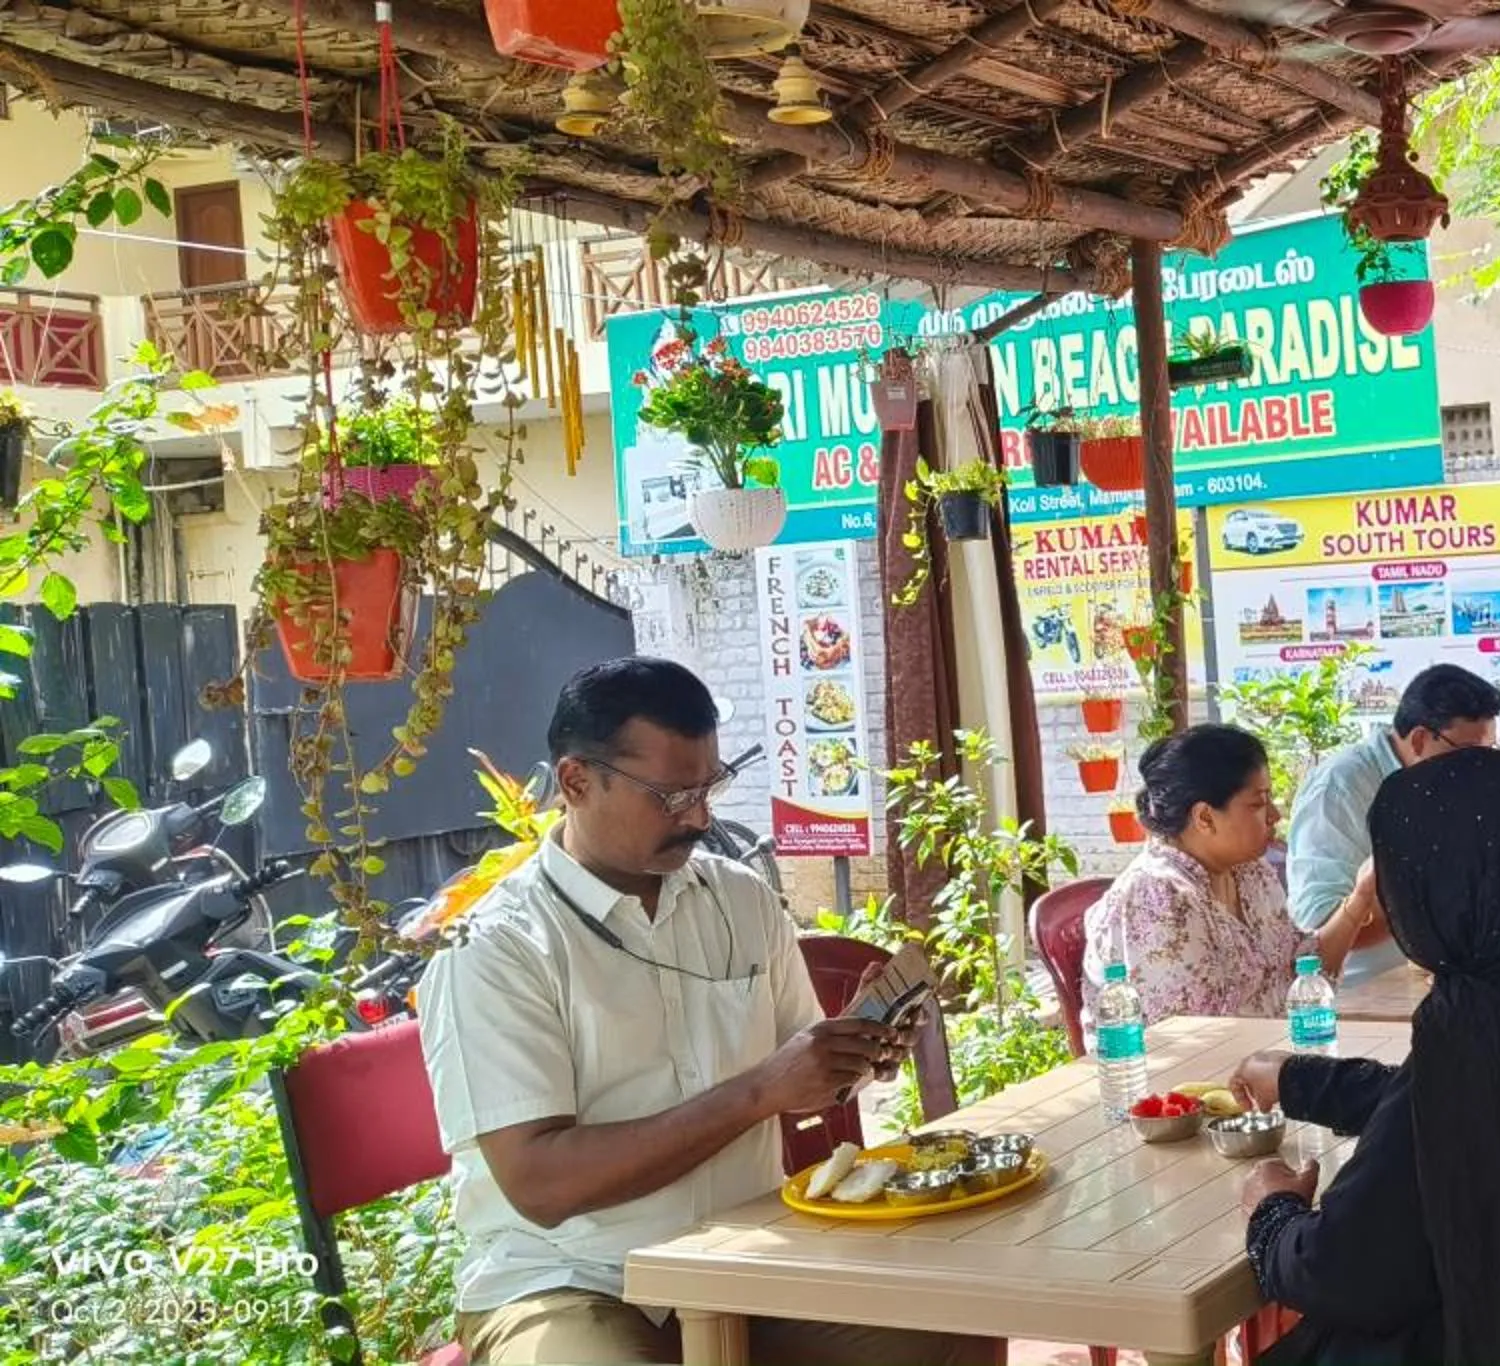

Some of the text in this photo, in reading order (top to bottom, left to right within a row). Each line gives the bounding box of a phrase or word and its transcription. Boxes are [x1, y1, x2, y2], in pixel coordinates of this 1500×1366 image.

[741, 293, 880, 334] 9940624526
[744, 321, 883, 362] 9840383570
[748, 366, 807, 442] RI
[1031, 318, 1173, 412] BEAC
[814, 445, 852, 490] AC
[1172, 391, 1335, 453] AILABLE
[1207, 474, 1267, 493] 603104.
[1356, 495, 1457, 527] KUMAR
[1322, 524, 1496, 557] SOUTH TOURS
[1024, 550, 1149, 579] RENTAL SERV
[768, 556, 798, 797] FRENCH TOAST
